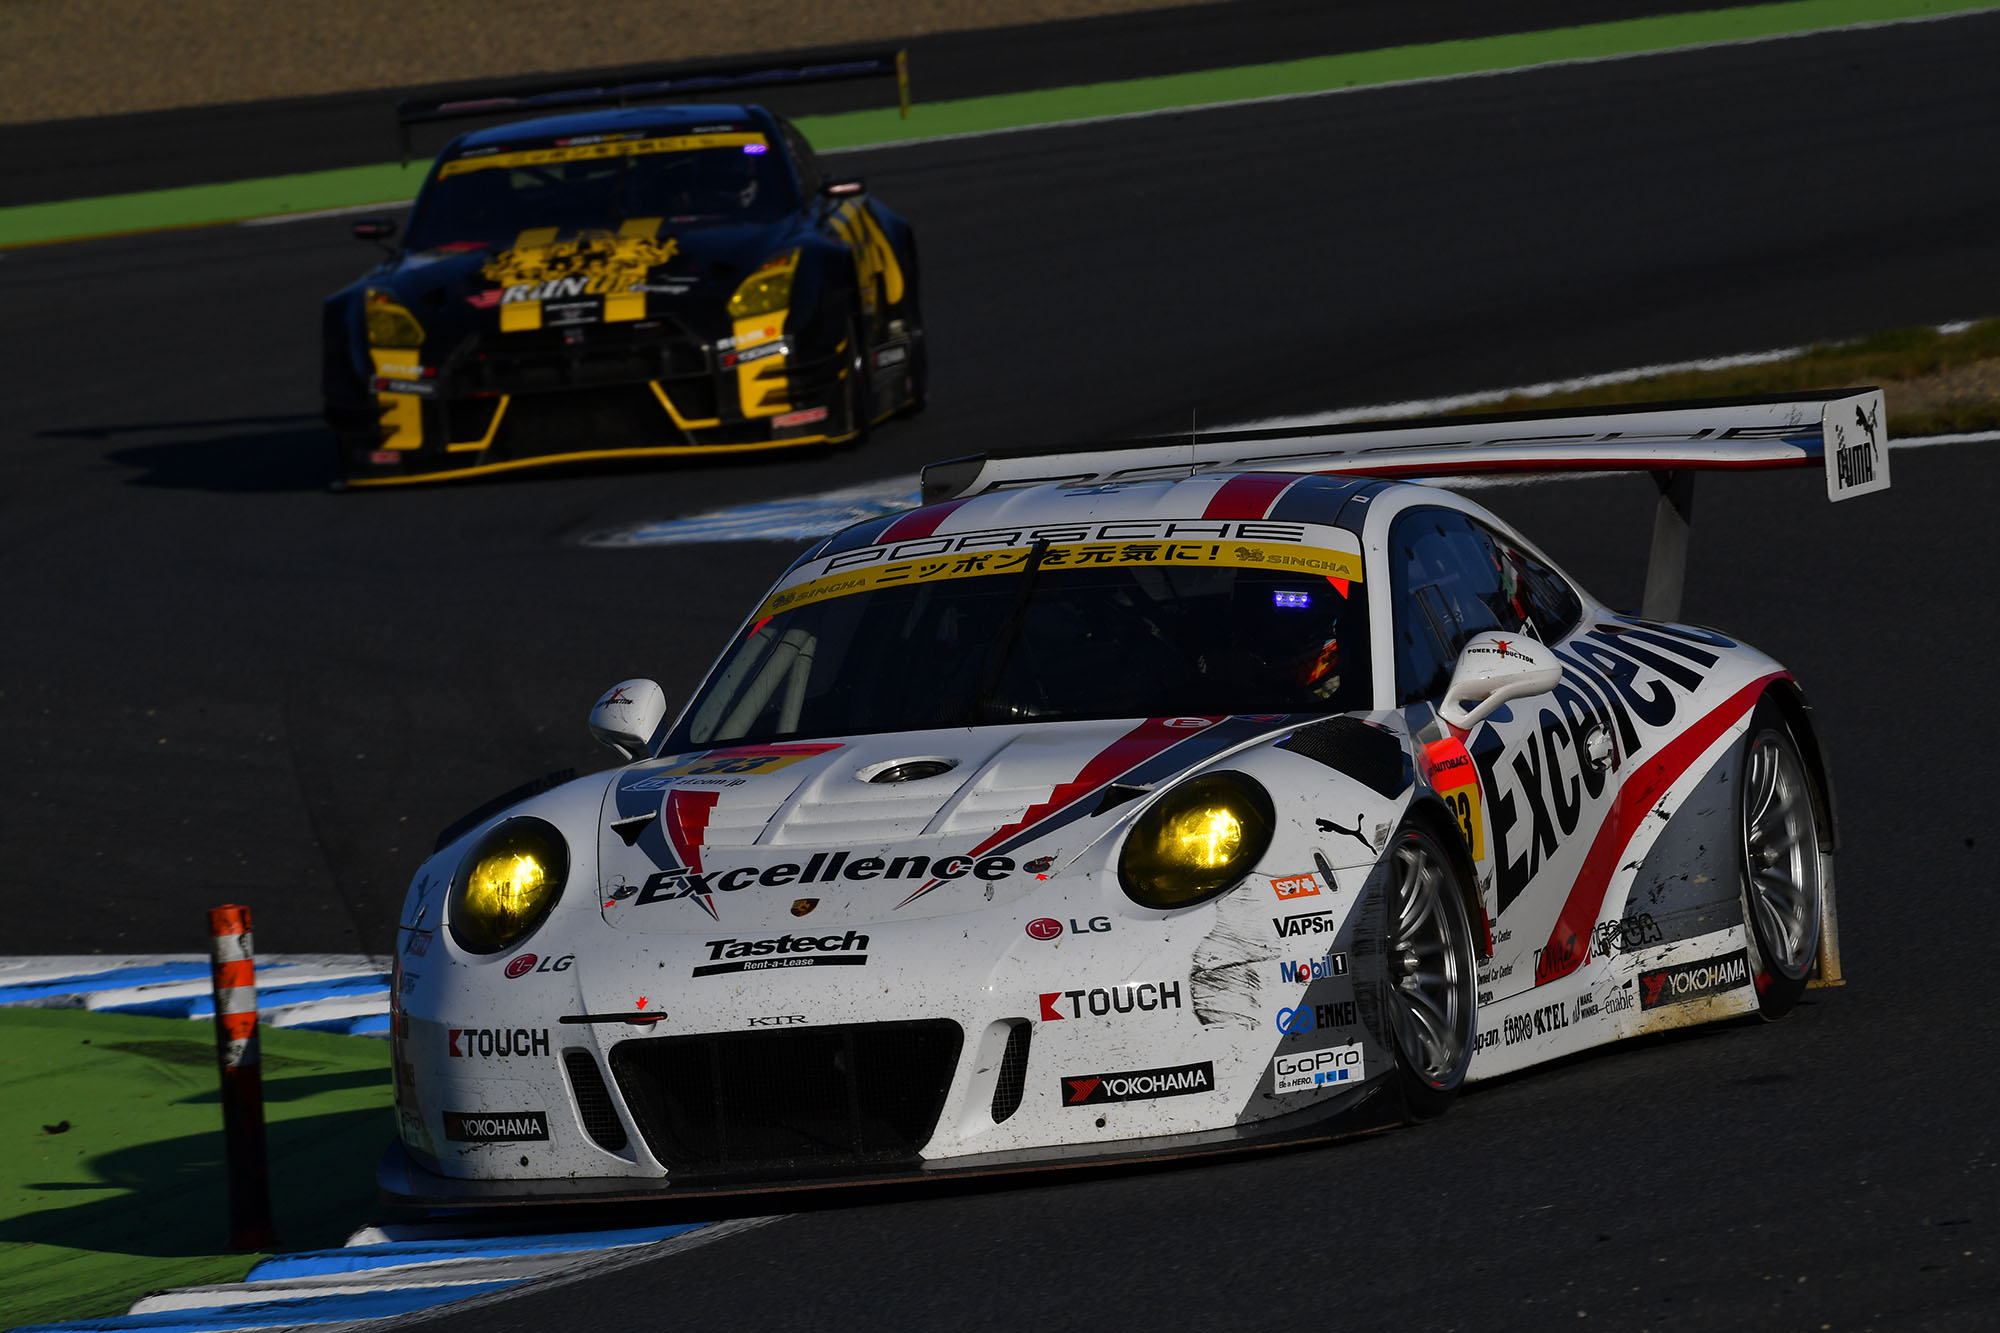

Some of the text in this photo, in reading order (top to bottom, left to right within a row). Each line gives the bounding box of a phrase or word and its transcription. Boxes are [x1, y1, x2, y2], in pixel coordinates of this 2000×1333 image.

[822, 523, 1305, 576] PORSCHE
[1266, 554, 1350, 575] SINGHA
[797, 577, 867, 602] SINGHA
[1433, 755, 1469, 773] AUTOBACS
[634, 851, 1016, 906] Excellence
[1069, 916, 1112, 934] LG
[704, 930, 870, 961] Tastech
[536, 955, 575, 973] LG
[743, 956, 814, 972] Rent-a-Lease
[1668, 957, 1747, 996] YOKOHAMA
[1605, 989, 1634, 1015] enable
[747, 1014, 808, 1028] KTR
[1316, 1001, 1357, 1030] ENKEI
[1277, 1050, 1359, 1075] GoPro
[1102, 1067, 1208, 1097] YOKOHAMA
[462, 1117, 543, 1136] YOKOHAMA
